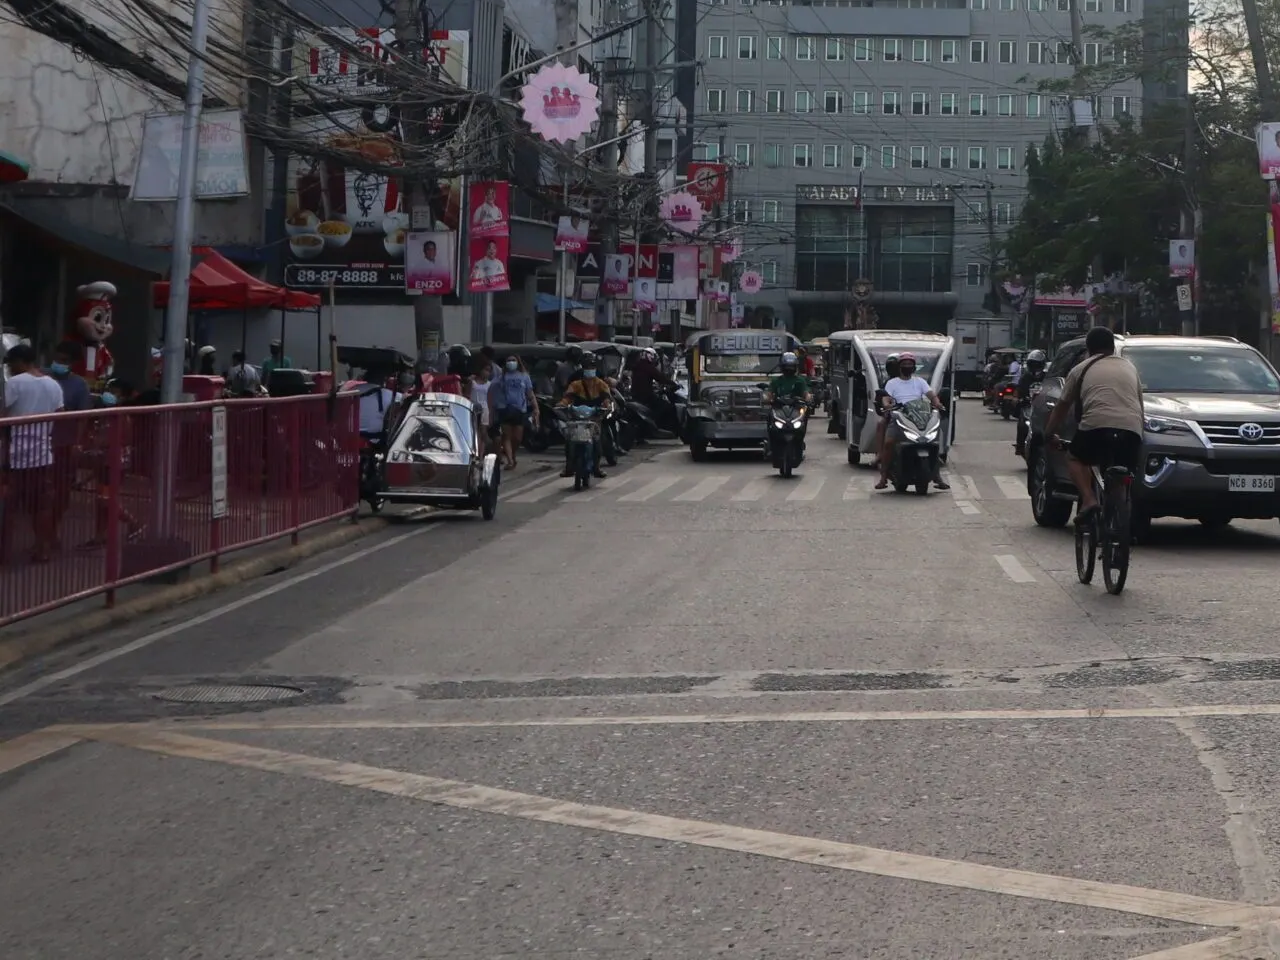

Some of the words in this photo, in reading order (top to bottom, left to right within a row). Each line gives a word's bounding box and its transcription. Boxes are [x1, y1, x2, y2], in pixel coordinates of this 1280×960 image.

[355, 221, 376, 229] KFC
[297, 269, 378, 283] 88-87-8888
[414, 280, 444, 290] ENZO
[1057, 321, 1079, 329] OPEN
[711, 335, 783, 351] REINIER
[1230, 478, 1246, 488] NCB
[1252, 478, 1274, 489] 8360
